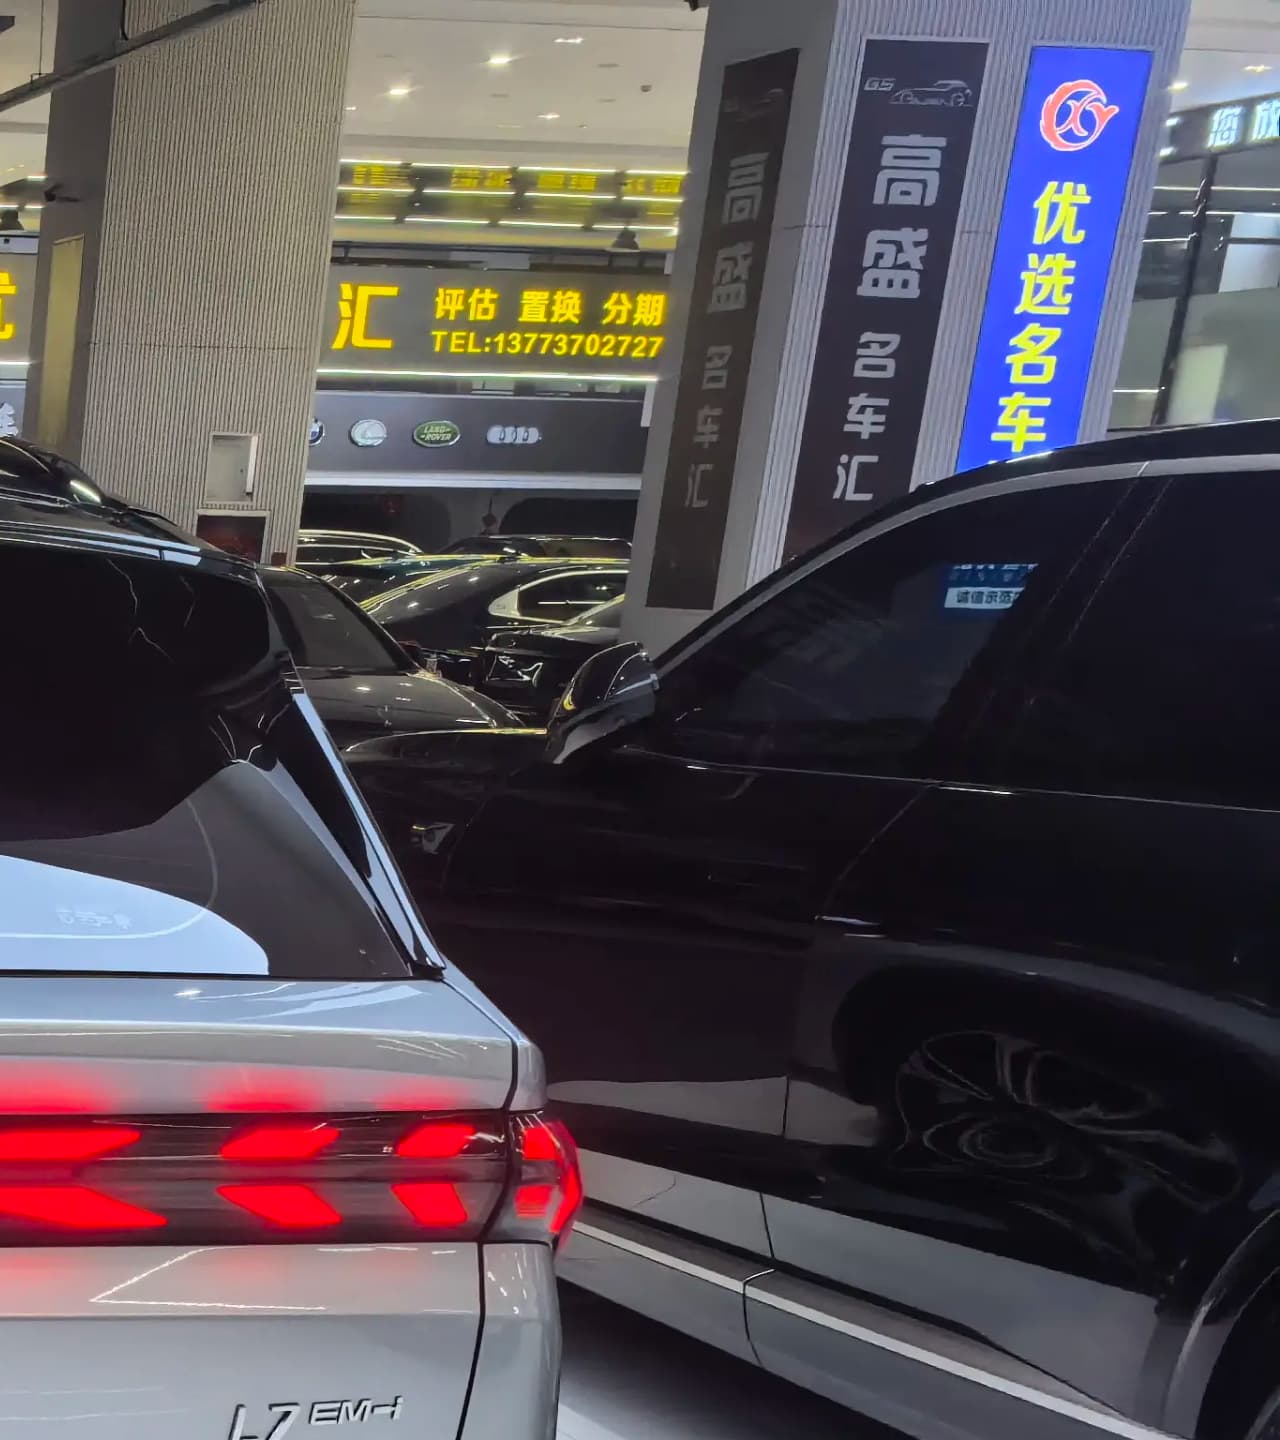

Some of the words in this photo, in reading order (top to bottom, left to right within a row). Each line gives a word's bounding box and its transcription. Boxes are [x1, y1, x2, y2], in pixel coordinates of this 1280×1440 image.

[330, 281, 401, 351] 汇
[435, 287, 499, 322] 评估
[518, 290, 582, 325] 置换
[602, 292, 668, 328] 分期
[832, 133, 948, 502] 高盛名车汇
[987, 181, 1092, 466] 优选名车
[431, 330, 666, 359] TEL:13773702727
